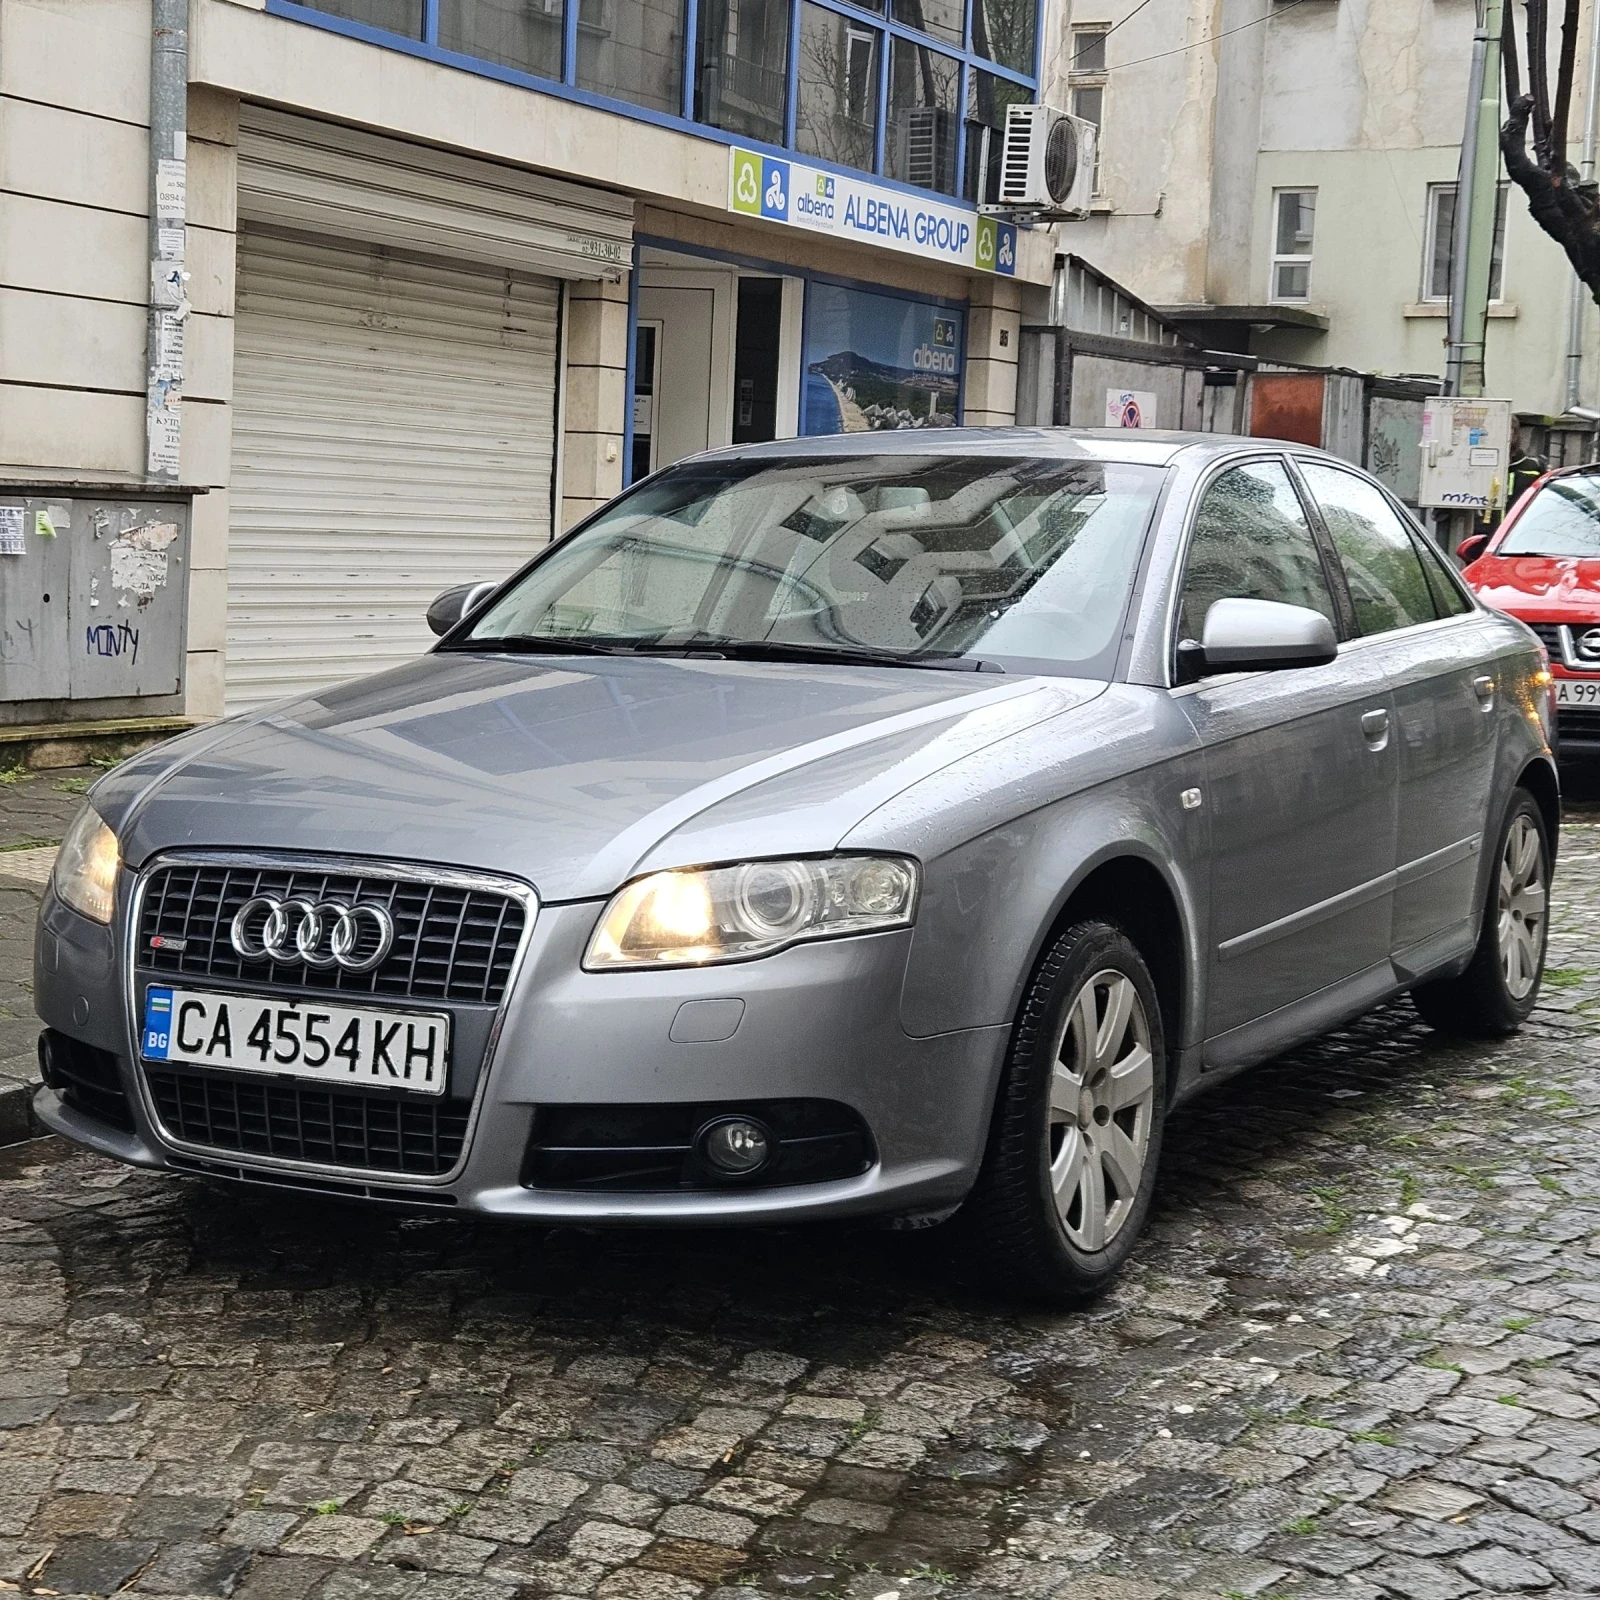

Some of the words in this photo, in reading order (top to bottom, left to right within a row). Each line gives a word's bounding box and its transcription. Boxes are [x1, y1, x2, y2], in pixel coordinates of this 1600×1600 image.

[797, 193, 834, 220] albena
[843, 194, 910, 241] ALBENA
[914, 212, 970, 253] GROUP
[589, 240, 622, 260] 931-30-02
[913, 343, 955, 373] albena
[86, 619, 139, 665] MINTY
[148, 1032, 168, 1049] BG
[177, 1000, 232, 1058] CA
[247, 1008, 361, 1072] 4554
[371, 1019, 437, 1081] KH
